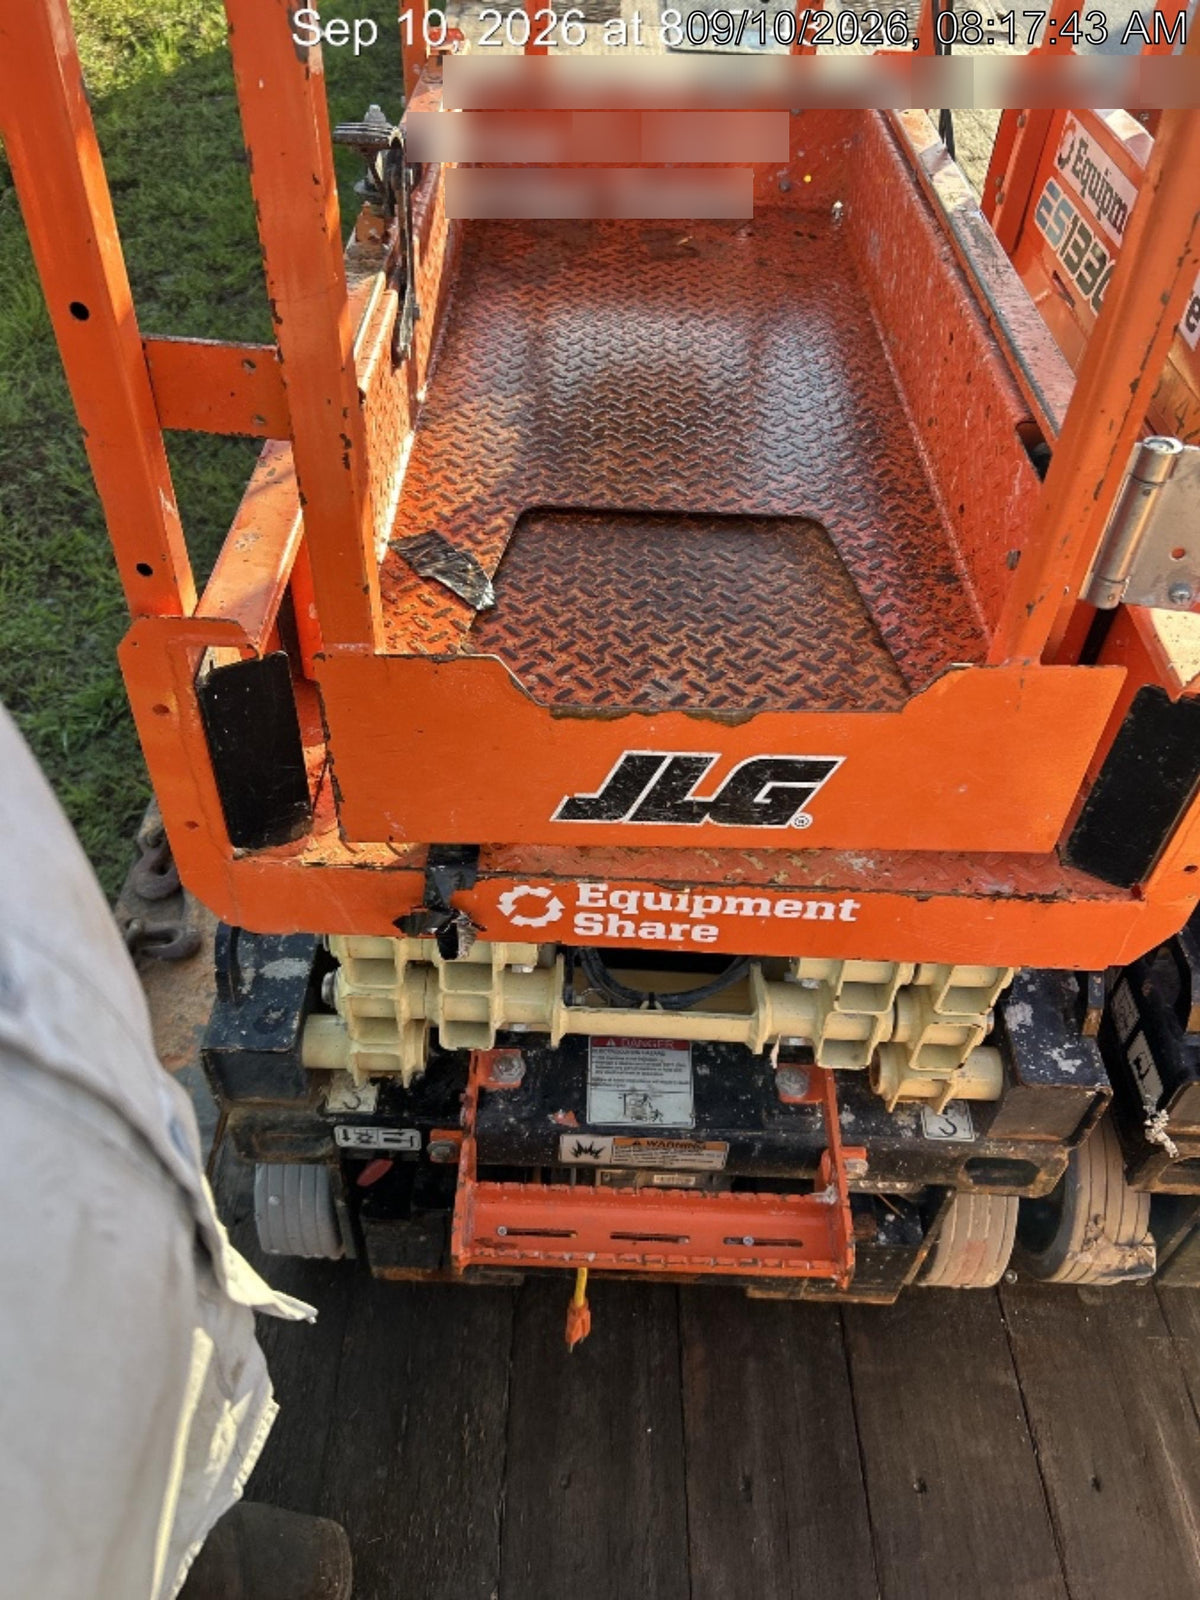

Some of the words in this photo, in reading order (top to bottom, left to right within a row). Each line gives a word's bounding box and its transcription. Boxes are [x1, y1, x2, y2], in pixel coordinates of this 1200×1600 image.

[1071, 136, 1129, 235] Equipm
[549, 749, 848, 829] JLG
[573, 911, 719, 943] Share
[575, 882, 862, 923] Equipment
